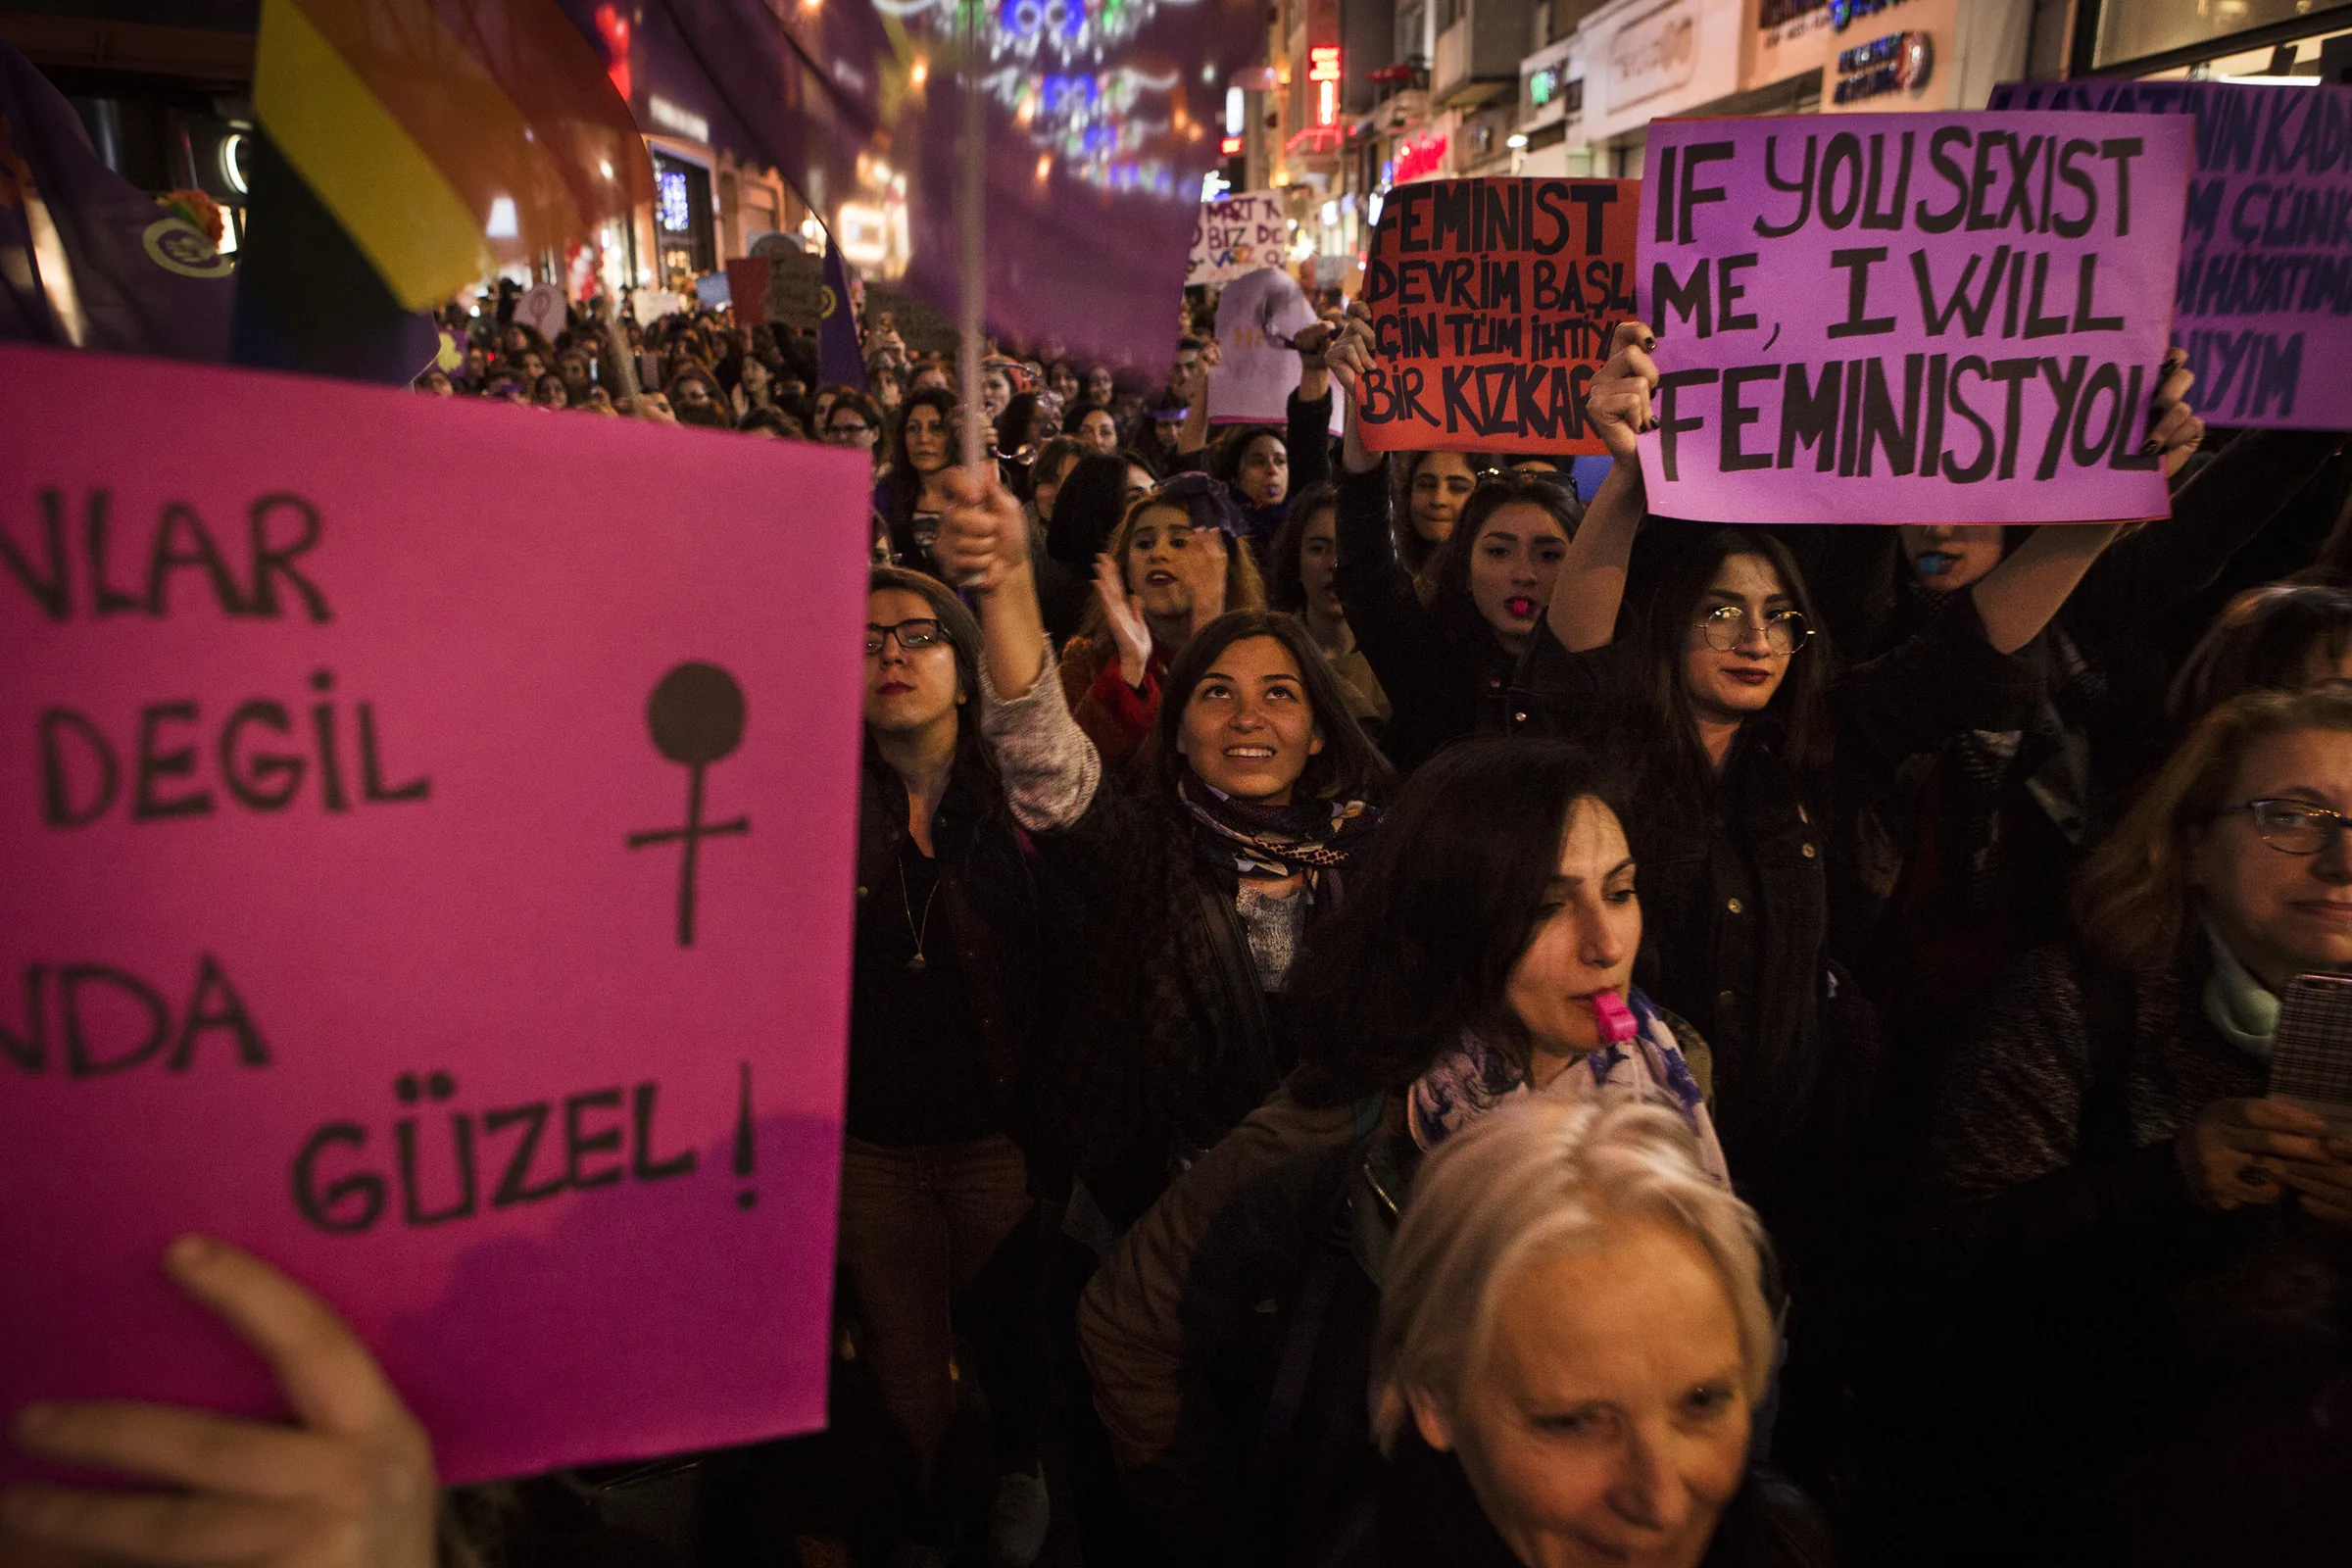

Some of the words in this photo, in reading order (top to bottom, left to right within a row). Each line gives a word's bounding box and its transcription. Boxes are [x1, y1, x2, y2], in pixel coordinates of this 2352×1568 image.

[1654, 140, 1734, 244] IF
[1366, 255, 1522, 314] DEVRİM
[1651, 252, 1781, 351] ME,
[1827, 245, 1896, 338] I
[1908, 244, 2125, 339] WILL
[1370, 308, 1439, 362] ÇİN
[1445, 313, 1522, 359] TÜM
[1531, 314, 1620, 362] İHTİY
[1360, 365, 1442, 426] BİR
